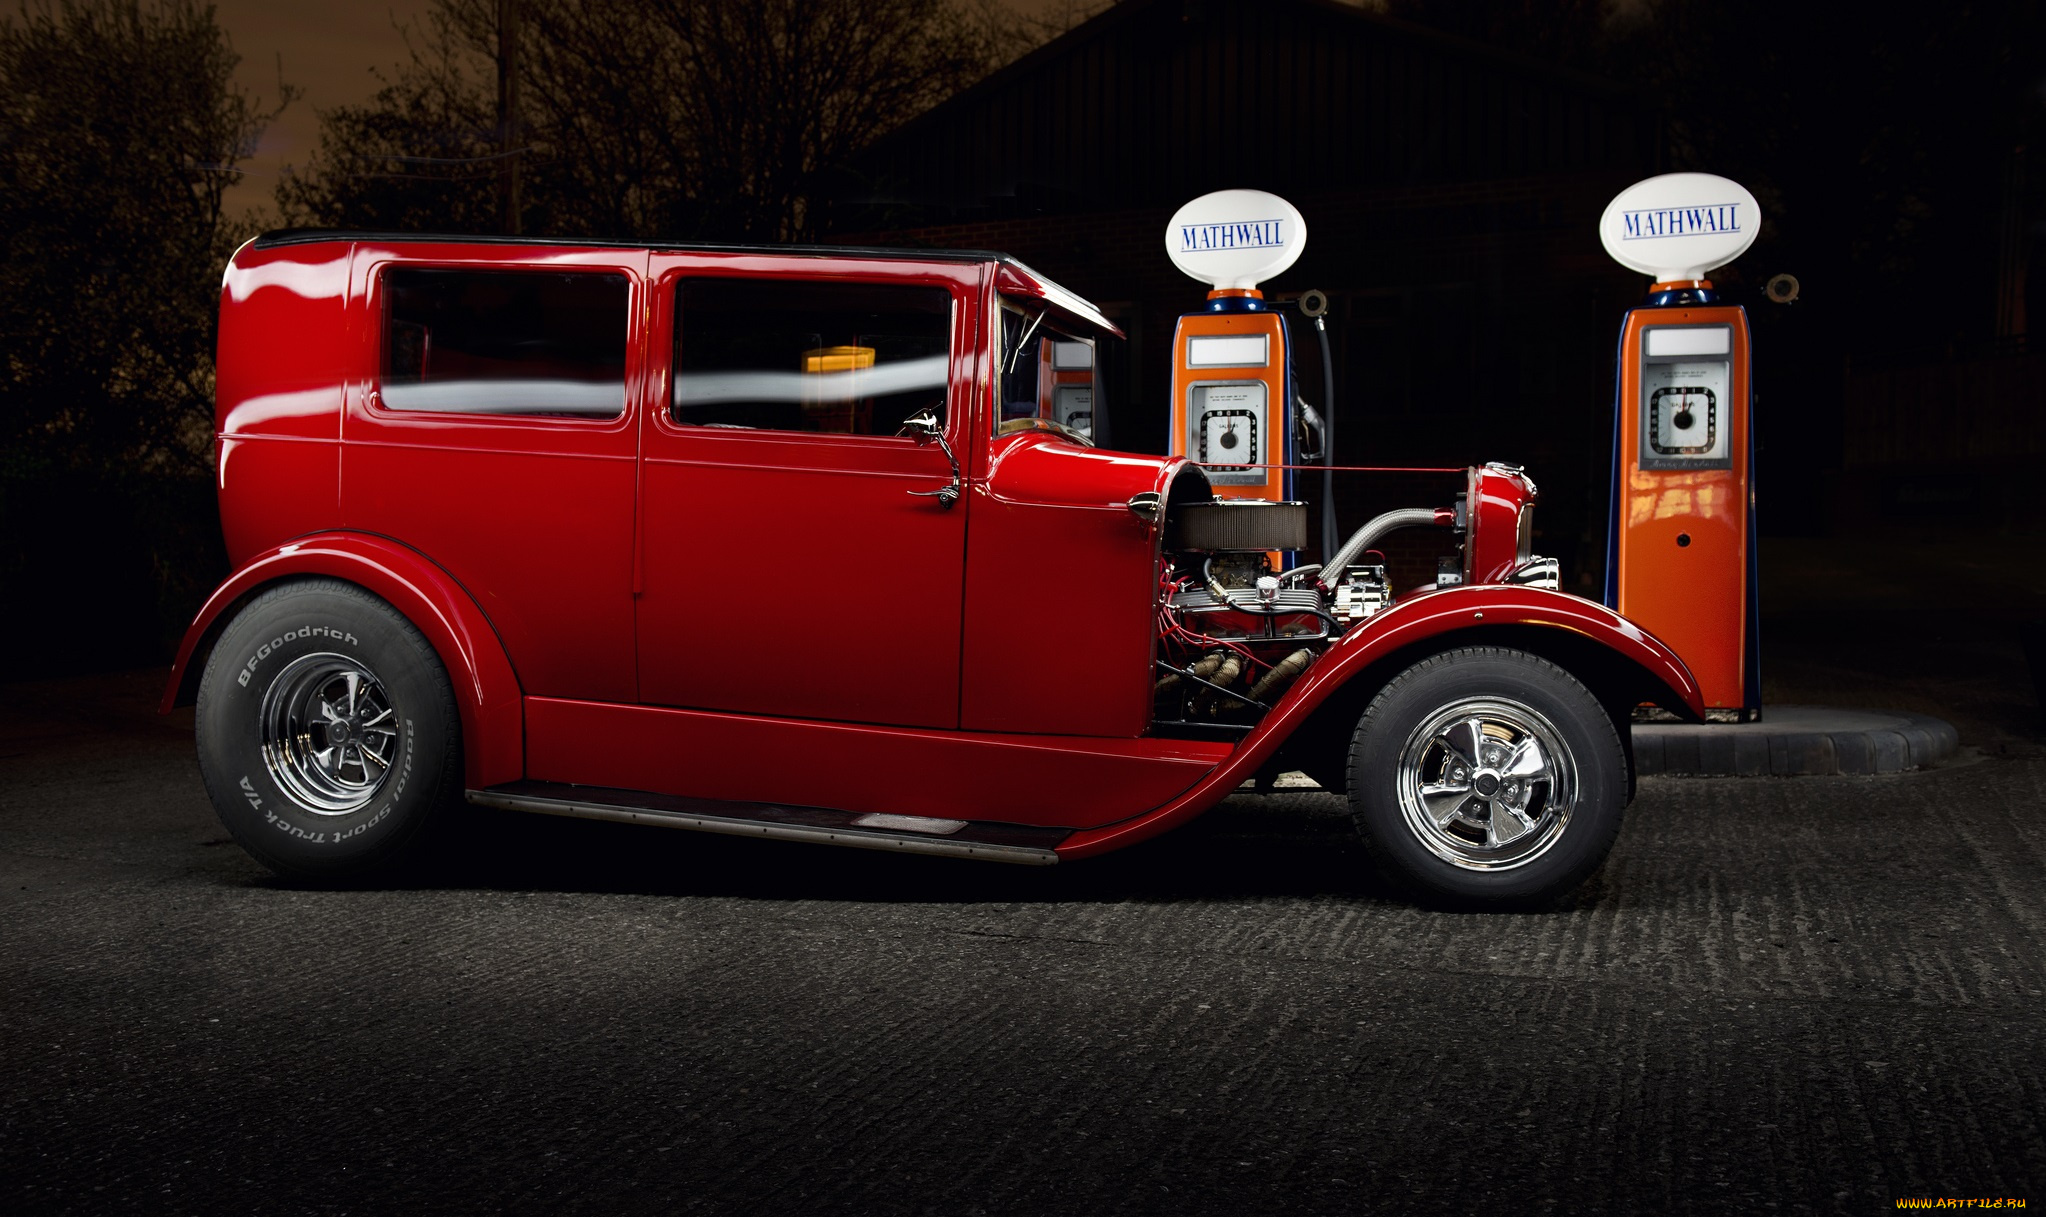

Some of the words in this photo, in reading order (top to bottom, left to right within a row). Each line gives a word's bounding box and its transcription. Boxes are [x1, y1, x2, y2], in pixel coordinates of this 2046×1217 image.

[1181, 222, 1284, 250] MATHWALL
[1623, 206, 1741, 238] MATHWALL
[238, 625, 358, 687] BFGoodrich
[393, 719, 414, 802] Radial
[240, 775, 262, 810] T/A
[264, 809, 326, 843] Truck
[332, 803, 391, 843] Sport
